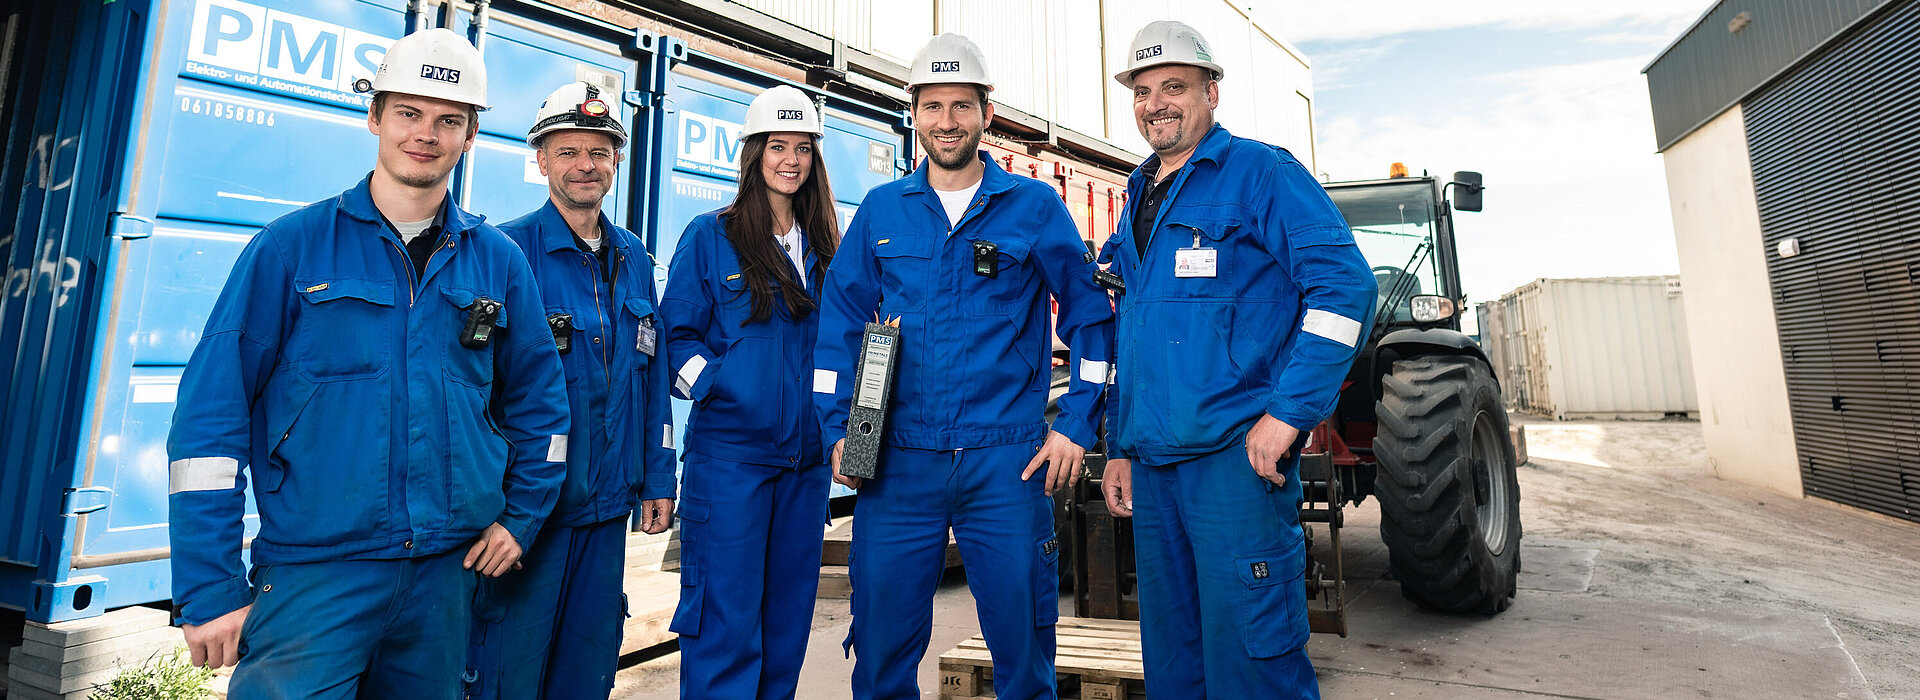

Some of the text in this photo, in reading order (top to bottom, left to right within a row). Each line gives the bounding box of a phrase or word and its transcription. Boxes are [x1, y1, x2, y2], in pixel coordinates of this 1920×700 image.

[1136, 45, 1162, 60] PMS
[422, 65, 459, 83] PMS
[932, 62, 959, 72] PMS
[186, 61, 232, 79] Elektro-
[234, 73, 258, 85] und
[259, 77, 363, 106] Automationstechnik
[181, 96, 275, 126] 061858886
[778, 110, 803, 120] PMS
[870, 335, 891, 345] PMS
